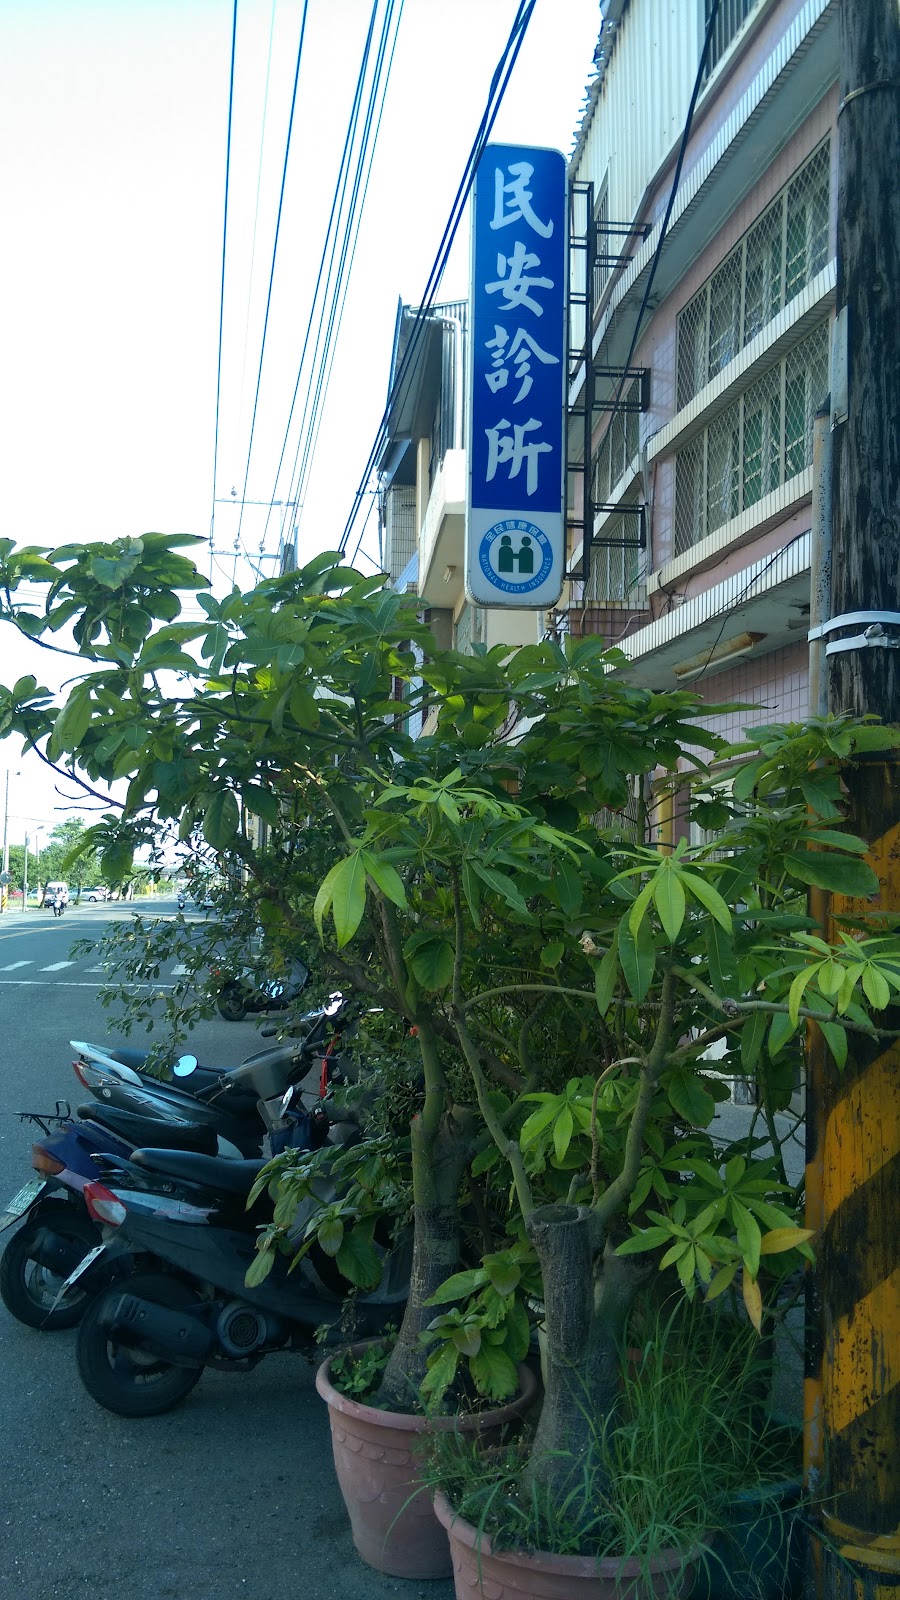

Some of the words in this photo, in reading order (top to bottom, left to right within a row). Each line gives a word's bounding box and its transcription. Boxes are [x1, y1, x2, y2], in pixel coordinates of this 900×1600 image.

[484, 161, 559, 496] 民安診所
[481, 554, 497, 584] NATIONAL
[500, 583, 526, 592] HEALTH
[528, 557, 551, 589] INSURANCE
